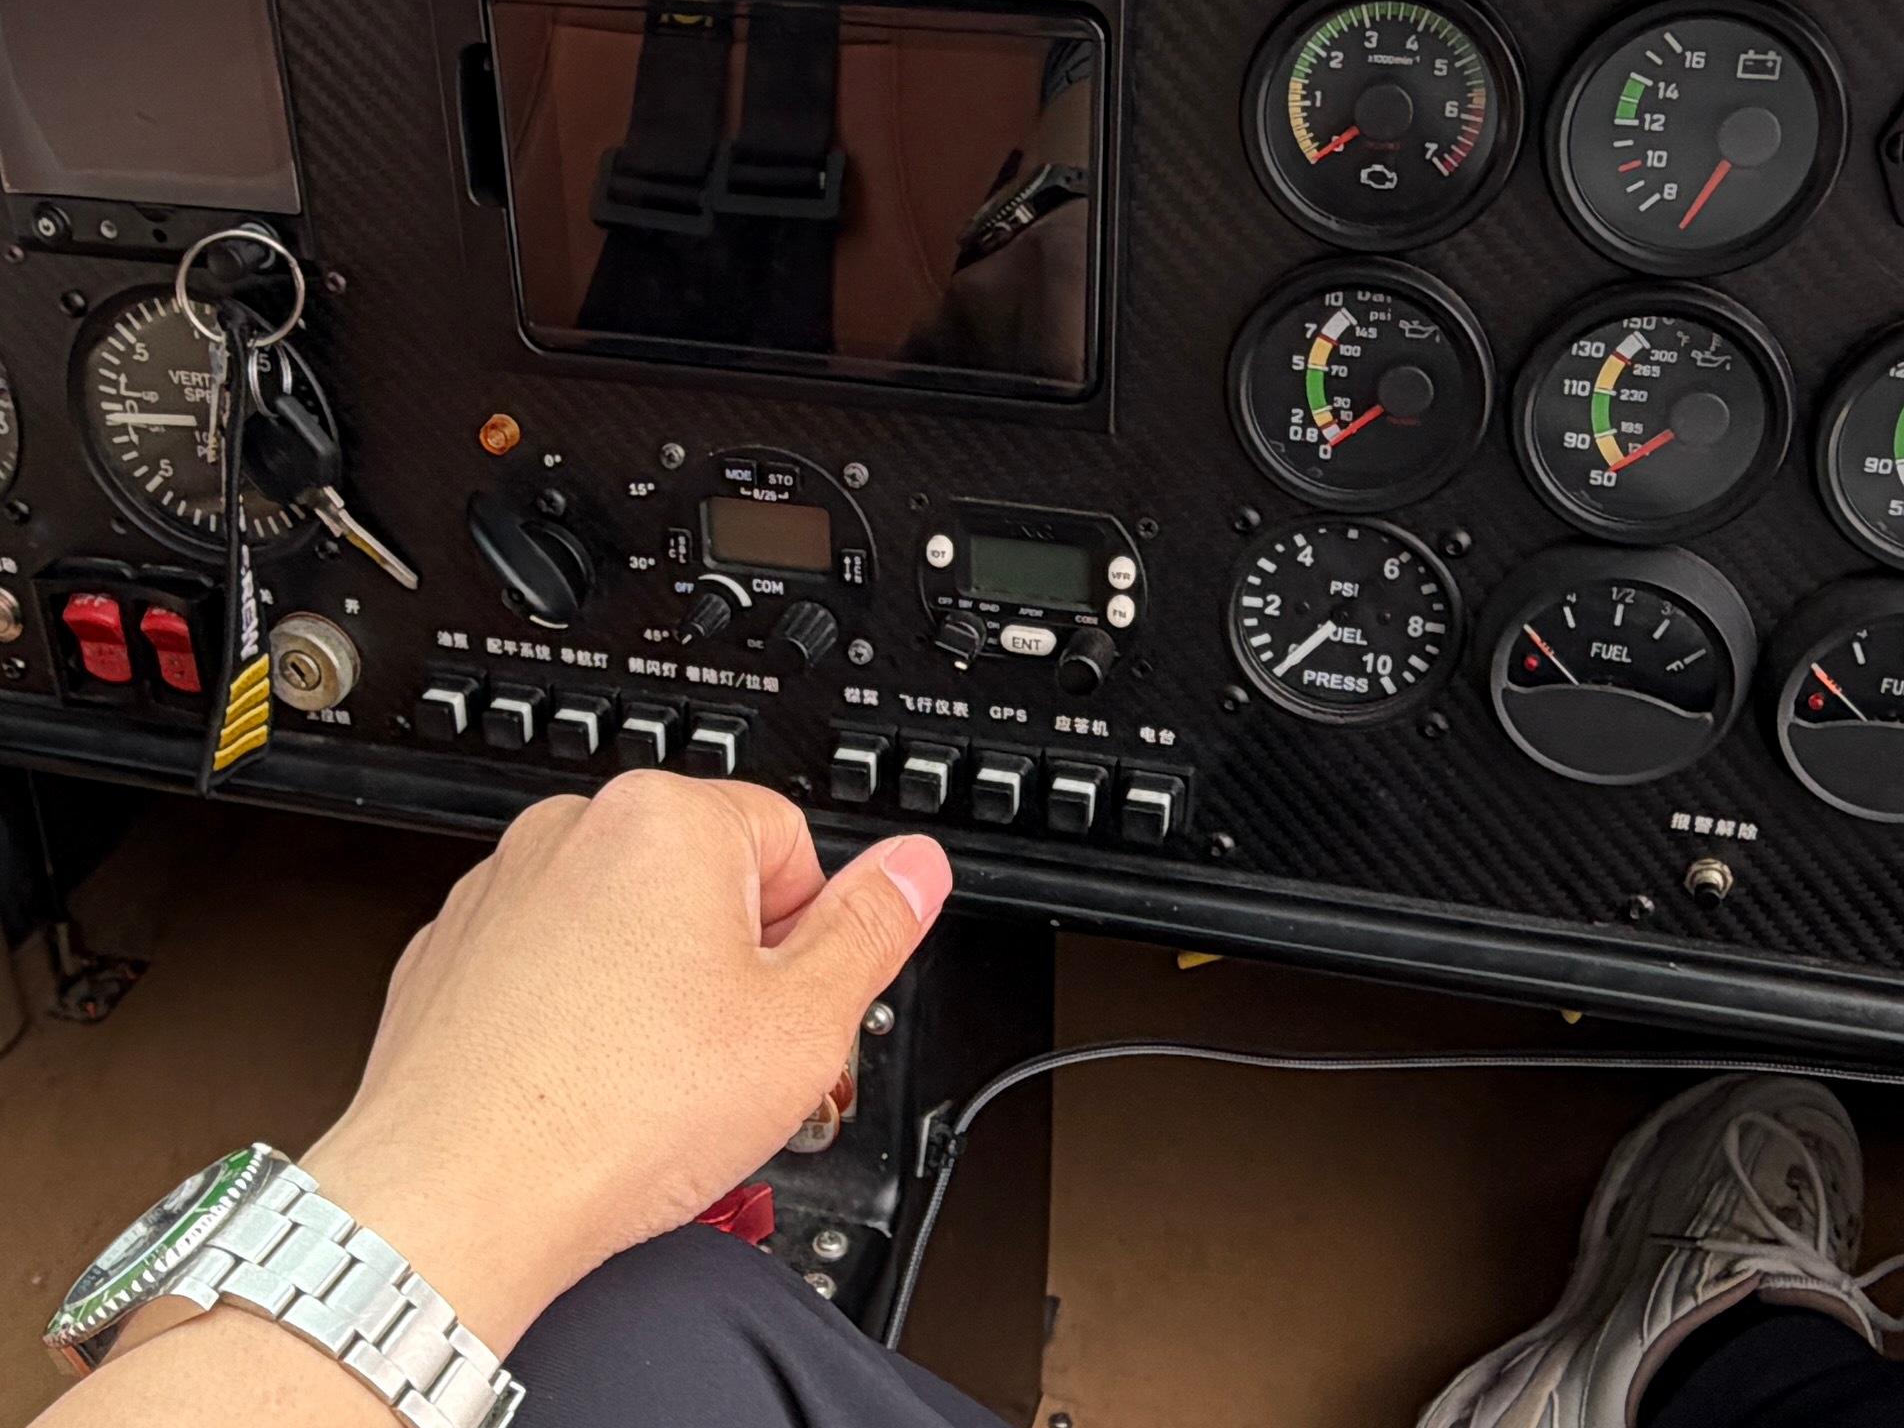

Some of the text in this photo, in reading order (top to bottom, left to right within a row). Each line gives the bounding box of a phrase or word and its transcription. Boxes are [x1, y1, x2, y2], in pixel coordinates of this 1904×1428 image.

[1364, 30, 1378, 49] 3
[1406, 34, 1419, 51] 4
[1329, 51, 1344, 69] 2
[1433, 58, 1449, 76] 5
[1684, 51, 1707, 69] 16
[1314, 90, 1323, 108] 1
[1658, 81, 1679, 100] 14
[1444, 100, 1459, 118] 6
[1644, 113, 1666, 132] 12
[1424, 142, 1438, 160] 7
[1646, 150, 1668, 168] 10
[1663, 183, 1678, 201] 8
[1325, 291, 1343, 307] 10
[1370, 308, 1392, 321] psi
[1304, 323, 1317, 339] 7
[1355, 326, 1377, 339] 145
[133, 343, 149, 362] 5
[1339, 345, 1361, 357] 100
[1571, 340, 1606, 358] 130
[1649, 349, 1678, 363] 300
[1292, 355, 1305, 371] 5
[1330, 365, 1348, 377] 70
[1632, 363, 1661, 378] 265
[1563, 379, 1591, 397] 110
[1619, 388, 1648, 402] 230
[1333, 396, 1351, 409] 30
[1291, 408, 1304, 424] 2
[1563, 431, 1591, 450] 90
[1319, 444, 1332, 460] 0
[159, 459, 174, 478] 5
[1864, 457, 1893, 475] 90
[768, 474, 794, 487] STO
[1589, 469, 1617, 487] 50
[1296, 544, 1315, 567] 4
[1383, 557, 1400, 580] 6
[752, 578, 784, 596] COM
[1329, 580, 1360, 599] PSI
[1611, 586, 1636, 604] 1/2
[1264, 594, 1282, 617] 2
[1317, 623, 1368, 646] UEL
[1407, 615, 1424, 638] 8
[1012, 636, 1042, 651] ENT
[1590, 641, 1632, 664] FUEL
[1361, 652, 1393, 676] 10
[1665, 659, 1685, 673] F
[1303, 669, 1369, 694] PRESS
[899, 693, 970, 719] 飞行仪表
[989, 705, 1028, 722] GPS
[1054, 715, 1110, 737] 应答机
[1139, 726, 1176, 746] 电台
[1670, 812, 1758, 840] 报警解除
